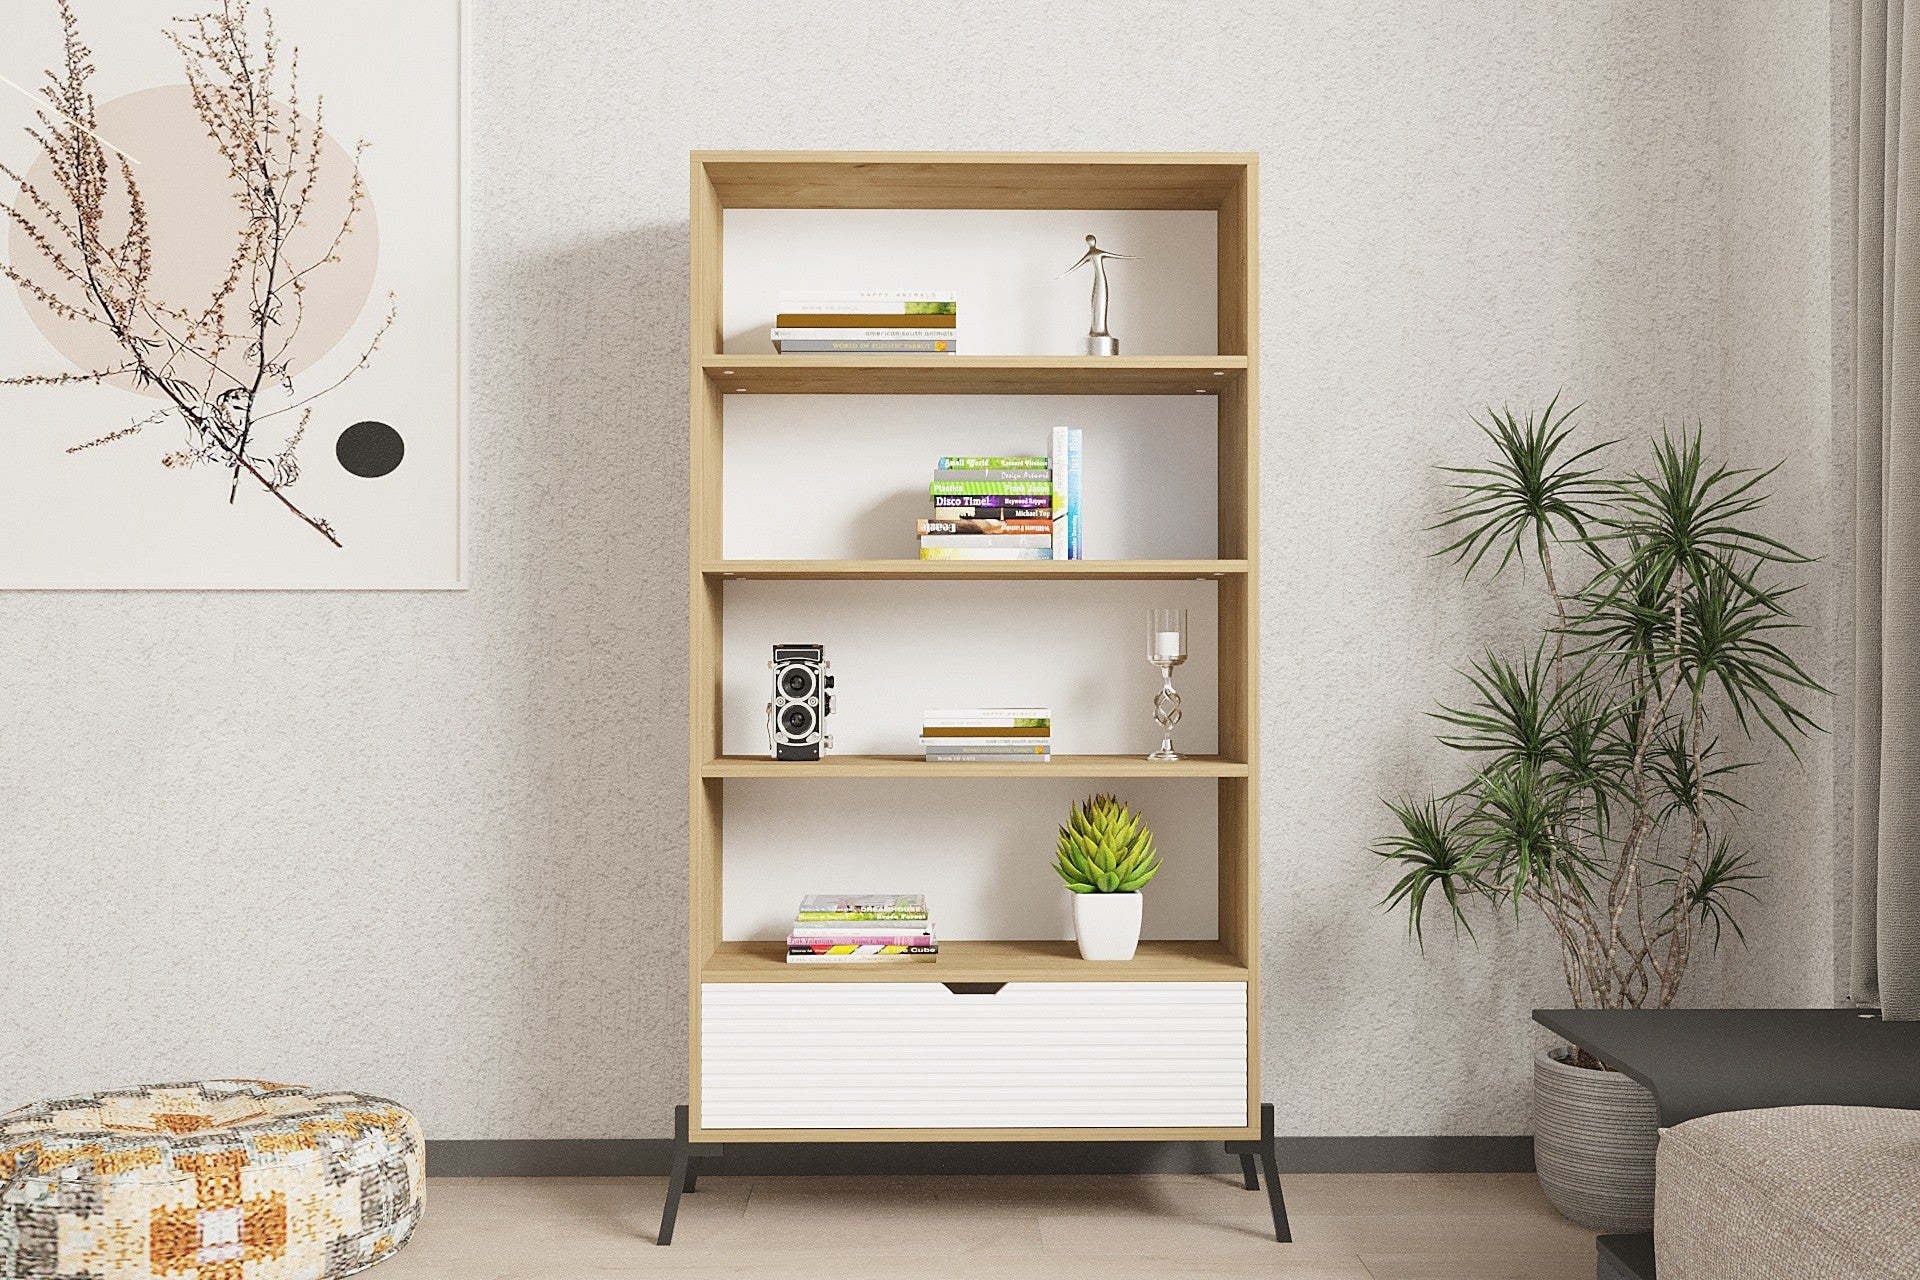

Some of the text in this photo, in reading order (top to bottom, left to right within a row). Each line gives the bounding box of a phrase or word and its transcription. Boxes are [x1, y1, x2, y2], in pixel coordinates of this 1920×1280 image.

[1070, 431, 1078, 472] Just Blue
[967, 458, 988, 468] World
[1001, 471, 1022, 480] Design
[1005, 484, 1025, 492] Frank
[1027, 484, 1050, 493] Jason
[936, 496, 962, 506] Disco
[963, 496, 991, 506] Time!
[1015, 510, 1039, 518] Michael
